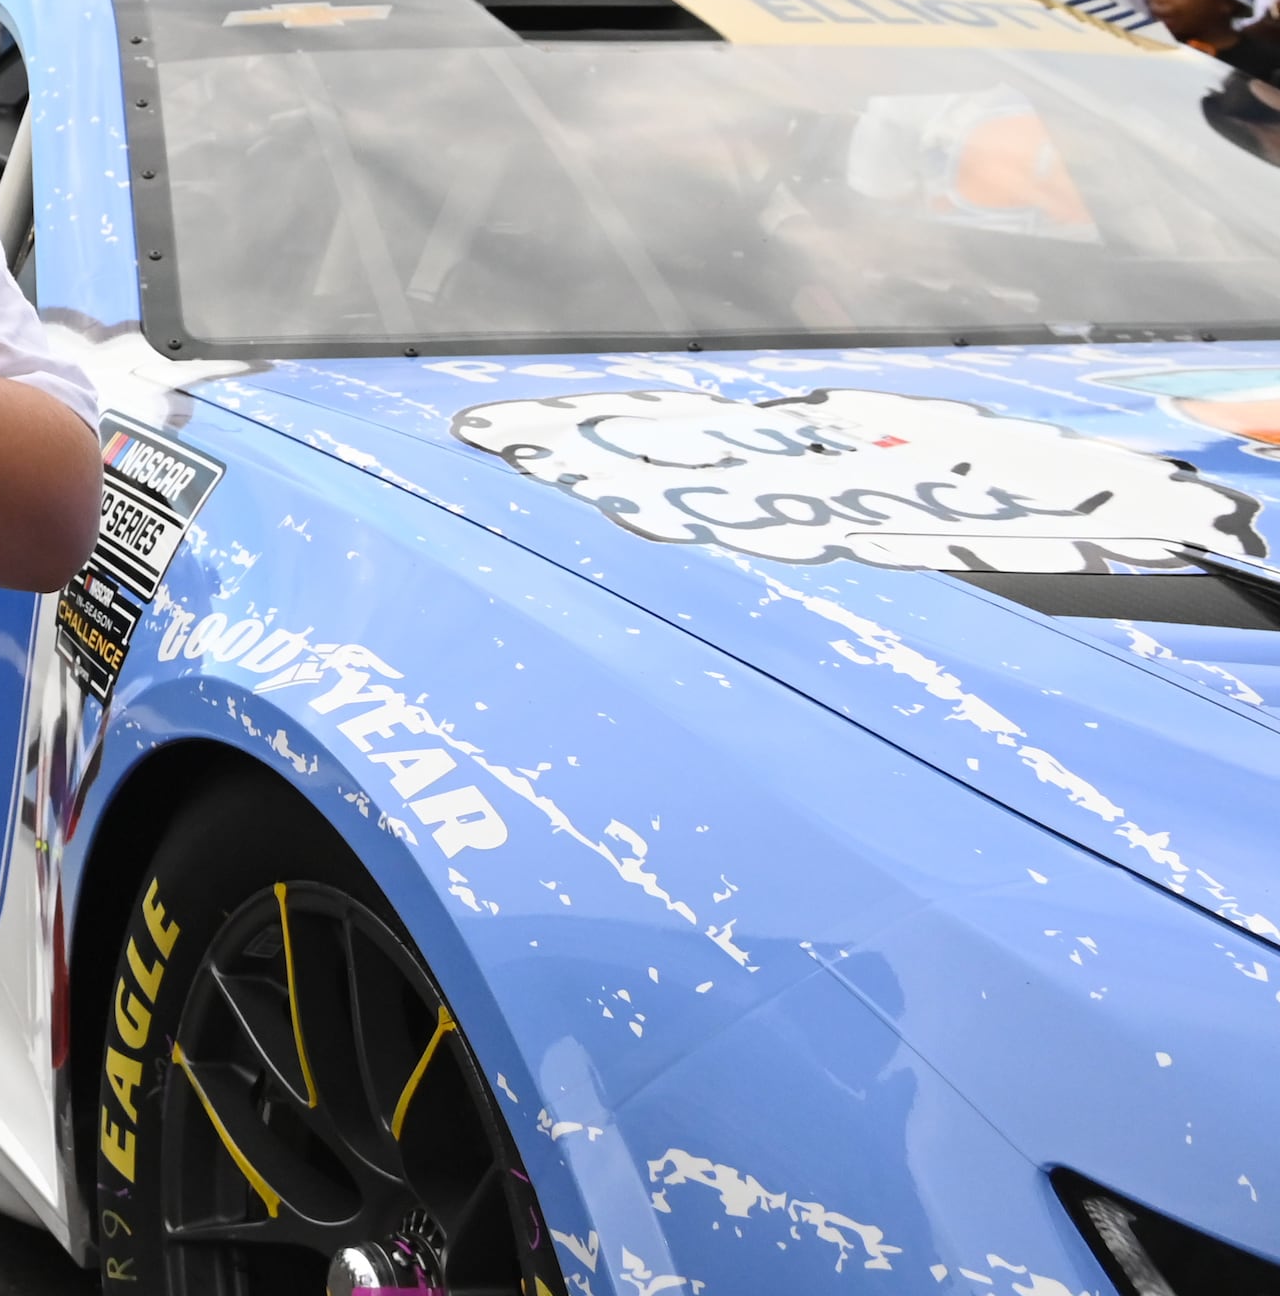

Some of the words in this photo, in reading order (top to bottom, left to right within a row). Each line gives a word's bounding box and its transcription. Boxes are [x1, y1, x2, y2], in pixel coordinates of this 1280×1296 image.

[116, 439, 196, 502] NASCAR
[106, 499, 165, 557] SERIES
[58, 599, 124, 671] CHALLENGE
[76, 593, 114, 632] IN-SEASON
[158, 613, 508, 860] GOODYEAR
[99, 876, 181, 1184] EAGLE
